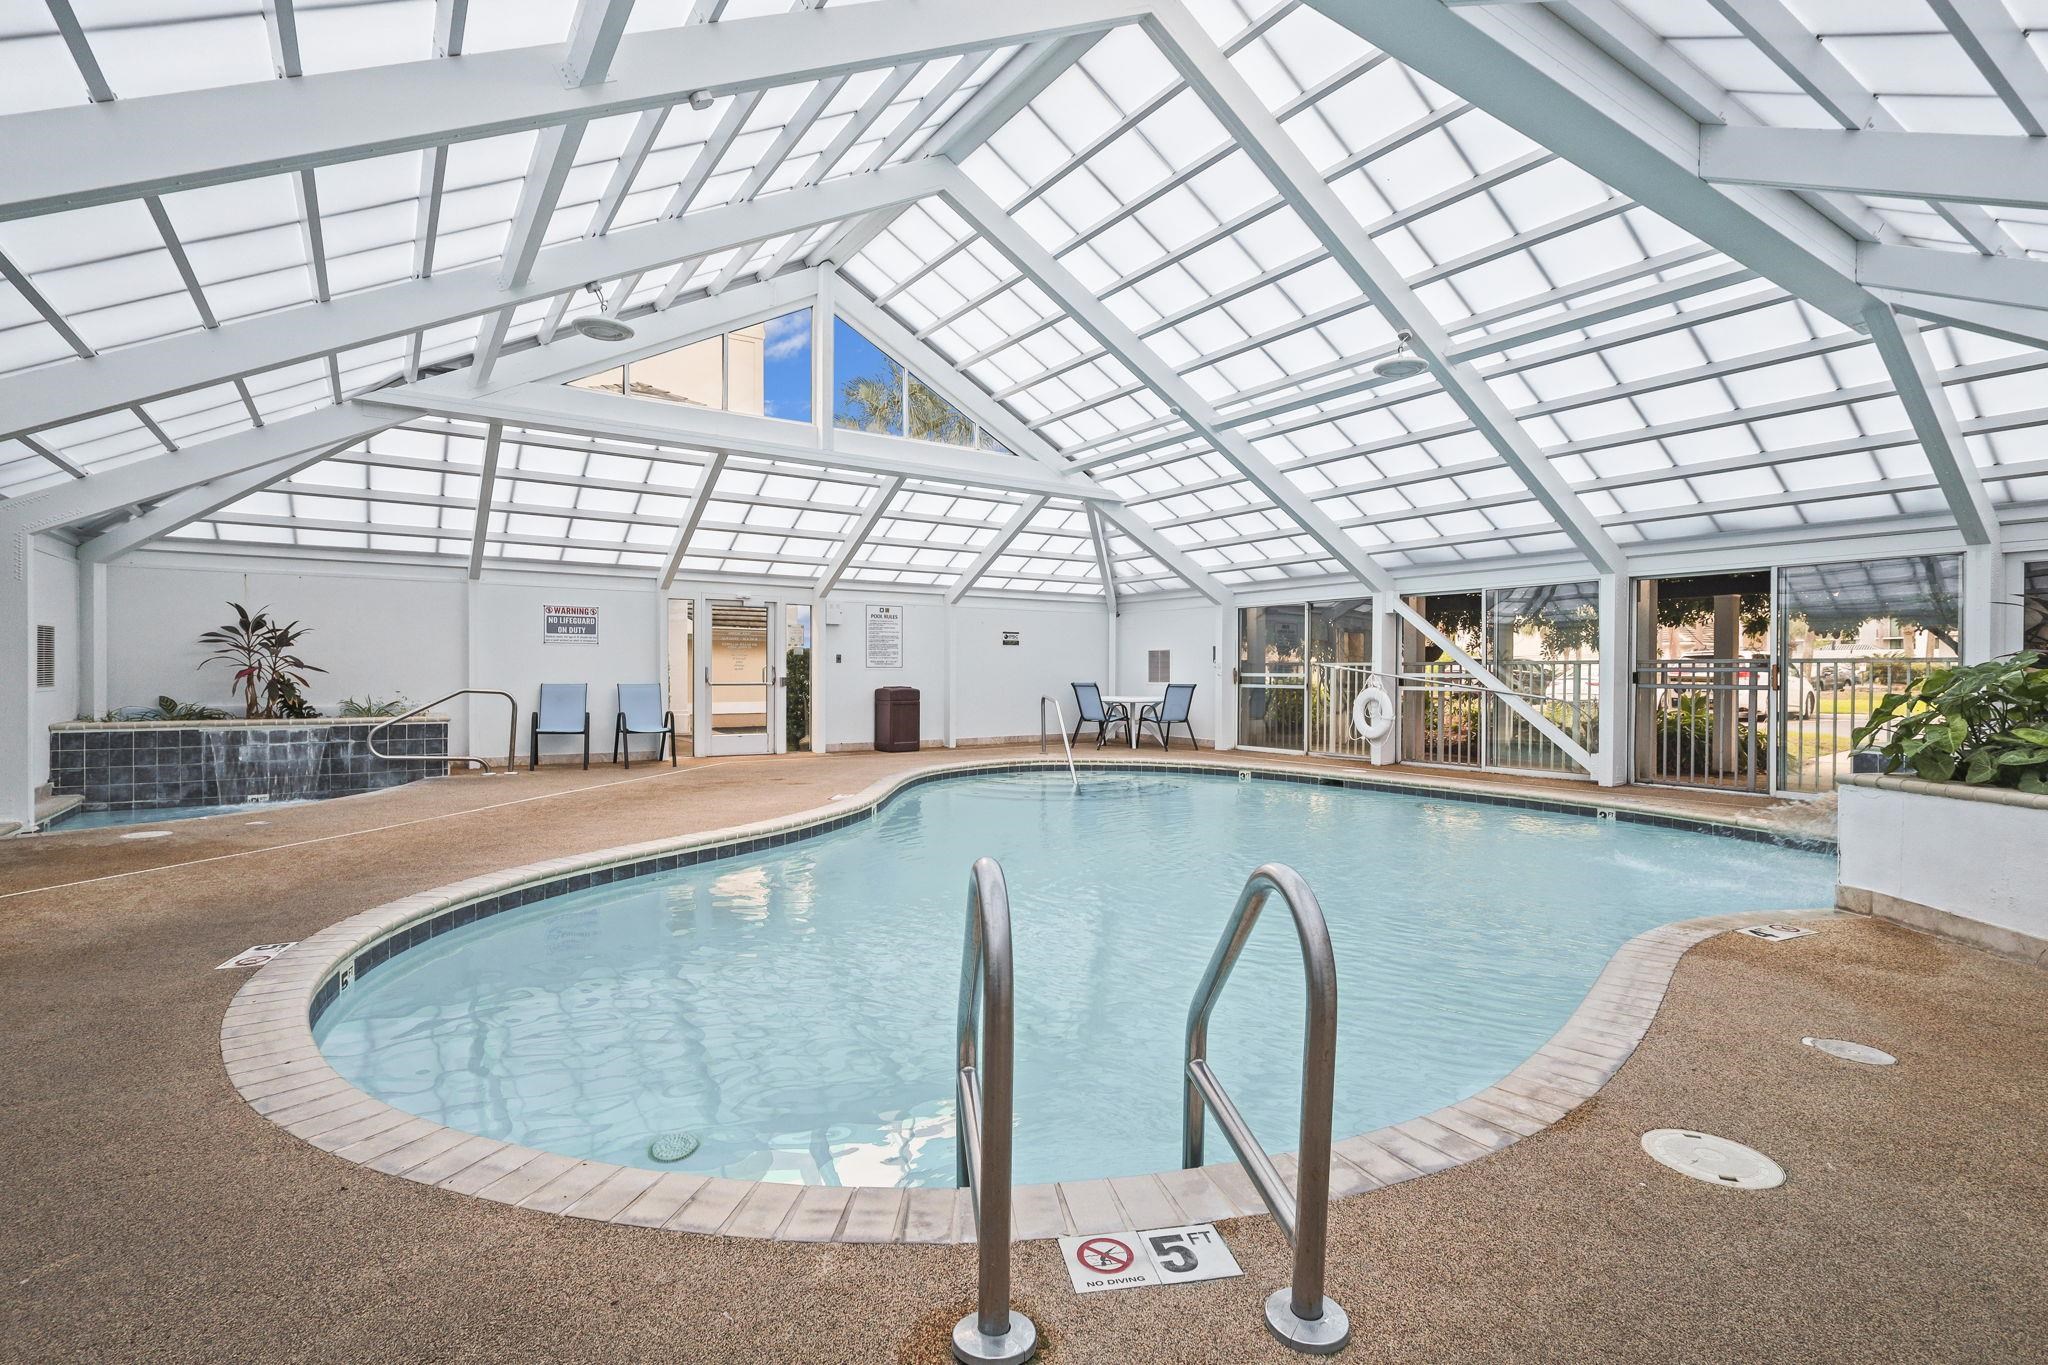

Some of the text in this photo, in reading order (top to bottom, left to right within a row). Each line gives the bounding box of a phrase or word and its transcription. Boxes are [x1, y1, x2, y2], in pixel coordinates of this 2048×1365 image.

[553, 606, 589, 615] WARNING
[548, 616, 595, 625] NO LIFEGUARD
[557, 626, 586, 634] ON DUTY
[1240, 772, 1246, 781] 3
[341, 970, 349, 991] 5
[1149, 1230, 1212, 1273] 5 FT
[1086, 1275, 1146, 1288] NO DIVING
